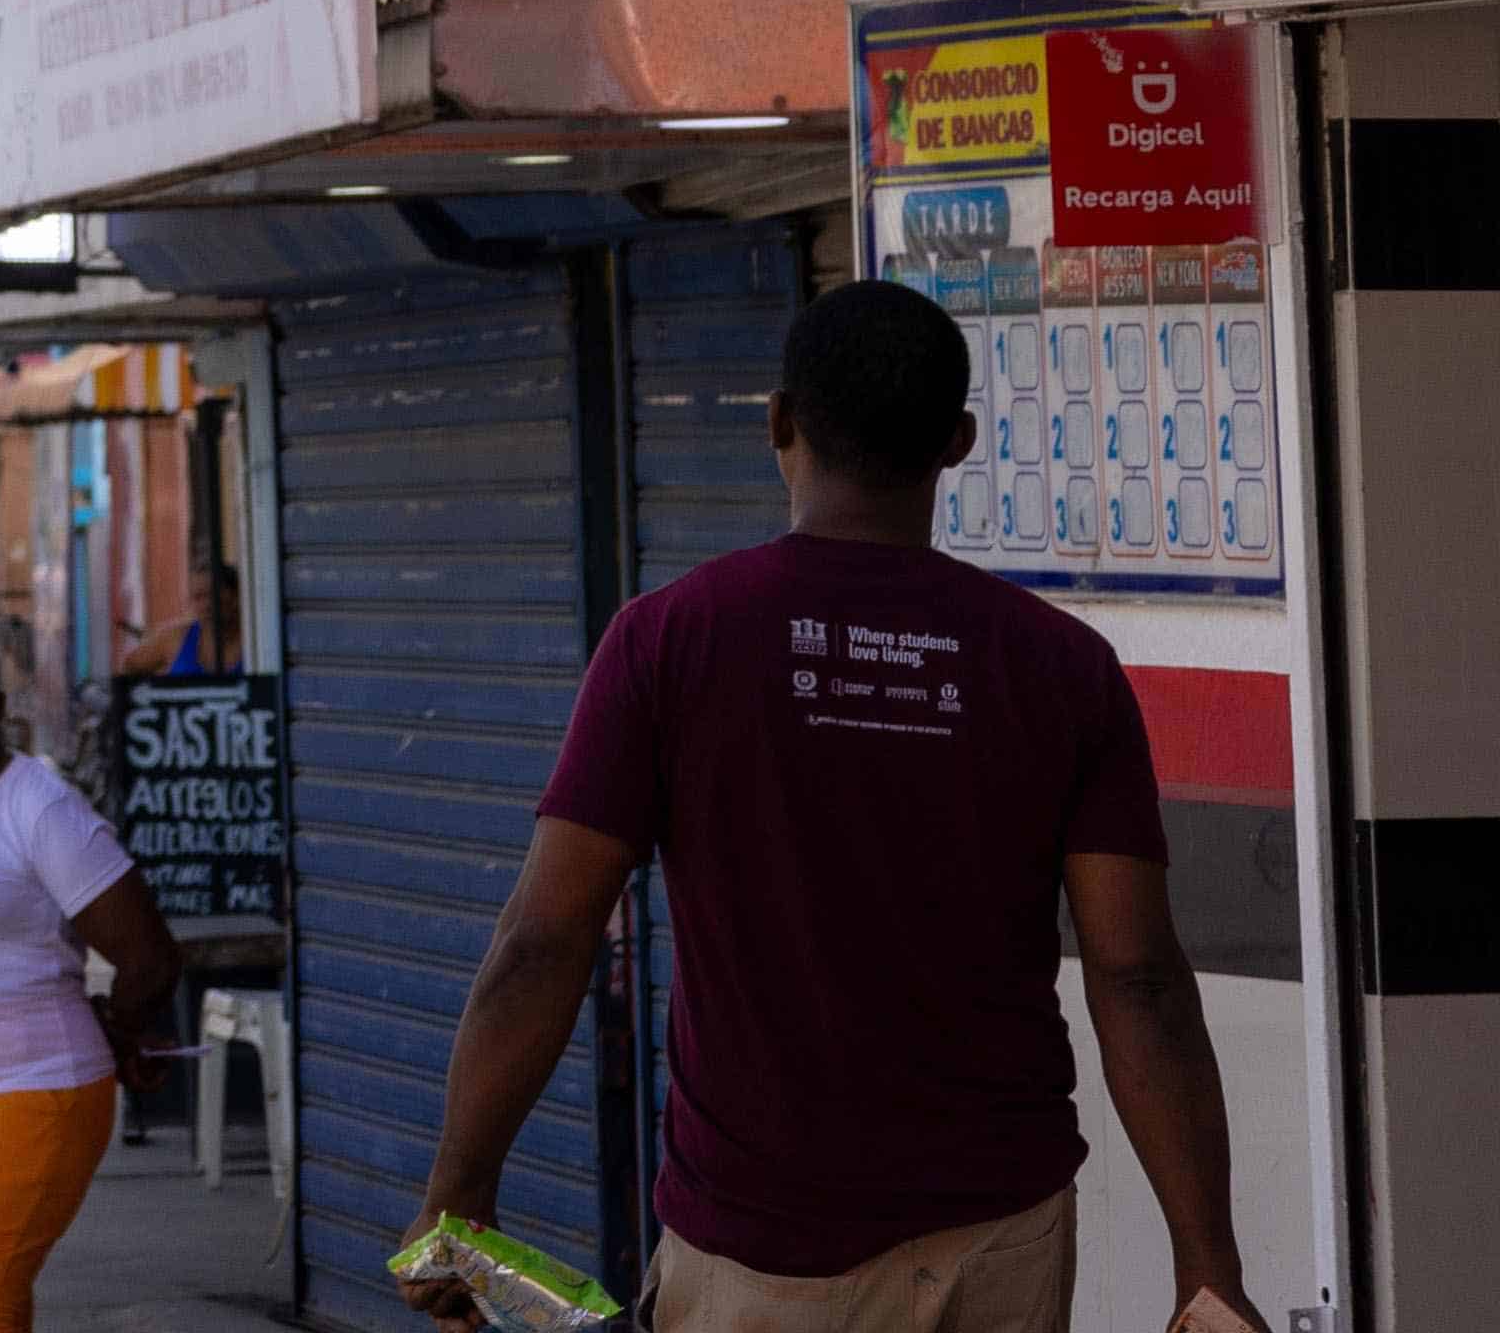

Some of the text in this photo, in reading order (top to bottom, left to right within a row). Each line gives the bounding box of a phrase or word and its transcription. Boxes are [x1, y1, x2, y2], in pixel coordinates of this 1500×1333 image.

[914, 62, 1039, 104] CONSORCIO
[916, 109, 1035, 151] DE BANCAS
[1107, 122, 1204, 153] Digicel
[920, 199, 996, 235] TARDE
[1064, 185, 1174, 212] Recarga
[999, 415, 1232, 461] 2 2 2 2 2
[948, 494, 1236, 545] 3 3 3 3 3 3
[847, 625, 960, 652] Where students
[848, 643, 879, 662] love
[124, 702, 277, 770] SASTRE
